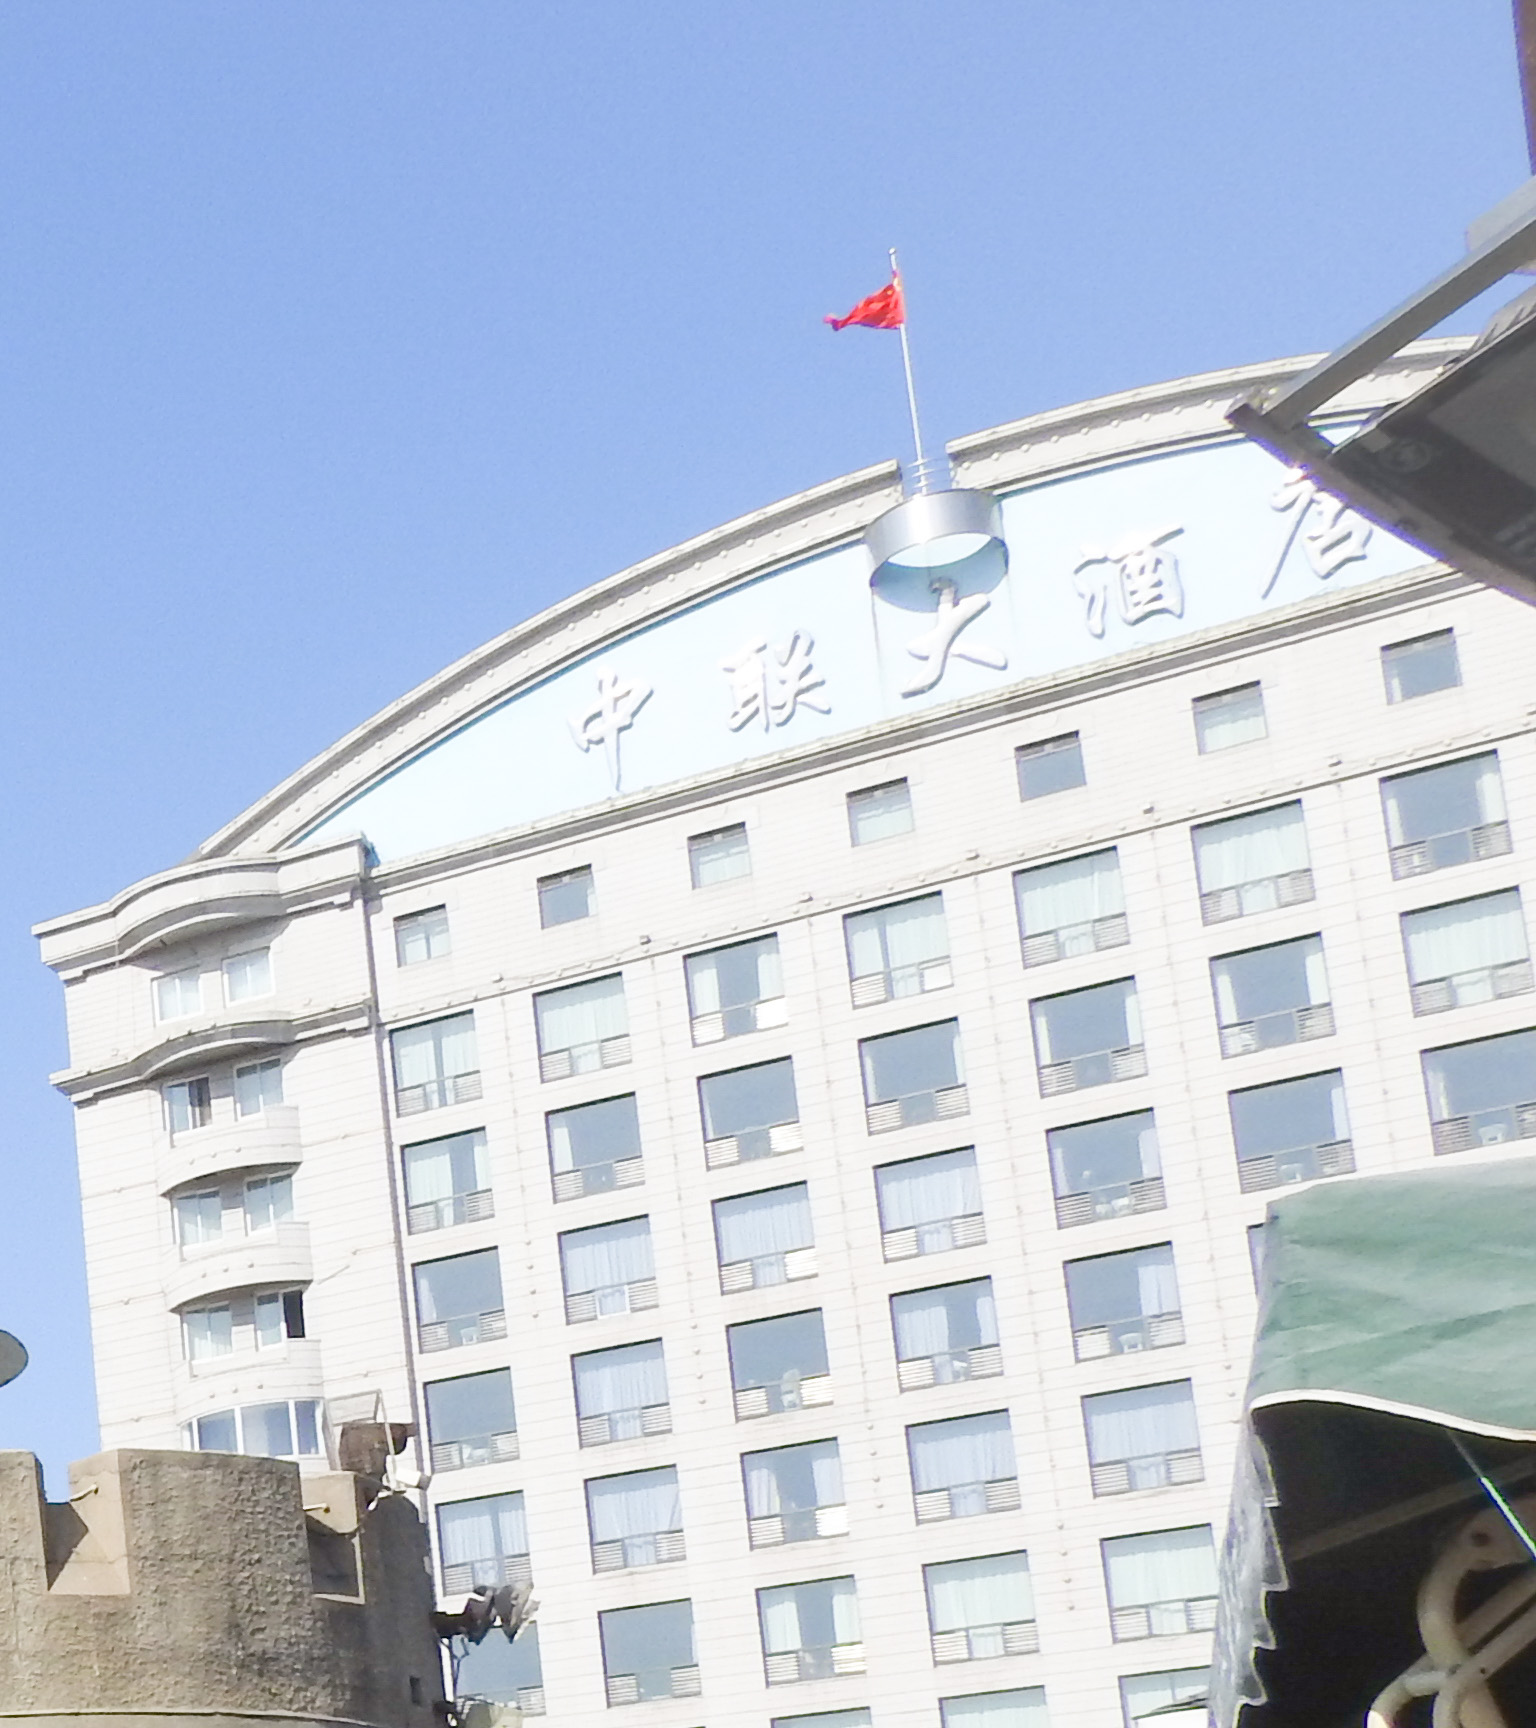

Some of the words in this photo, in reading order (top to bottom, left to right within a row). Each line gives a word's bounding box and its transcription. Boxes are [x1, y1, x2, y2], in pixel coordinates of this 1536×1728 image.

[566, 466, 1374, 792] 中联大酒店
